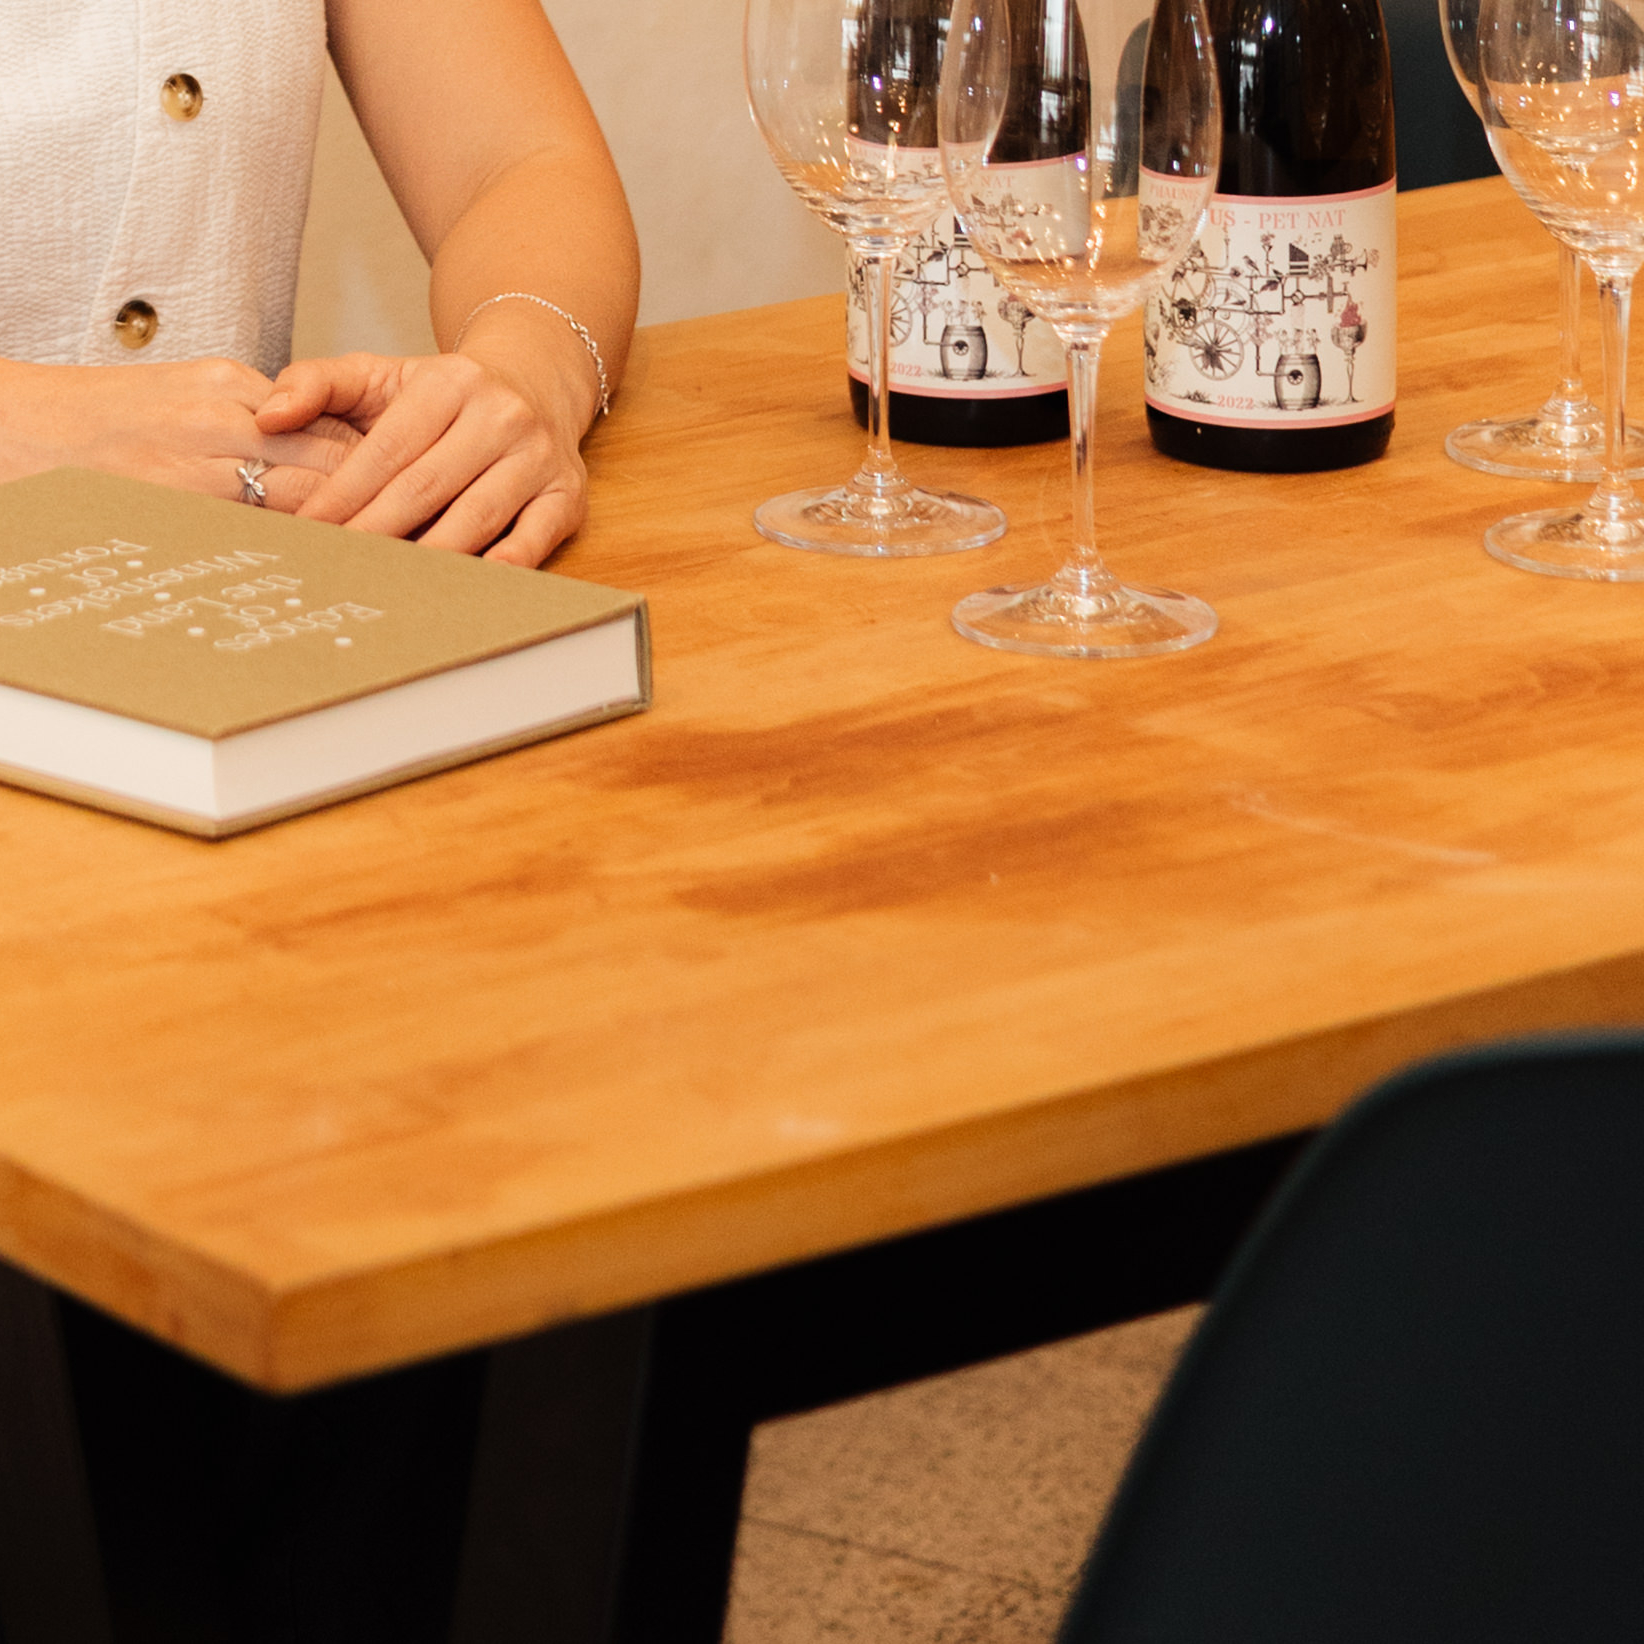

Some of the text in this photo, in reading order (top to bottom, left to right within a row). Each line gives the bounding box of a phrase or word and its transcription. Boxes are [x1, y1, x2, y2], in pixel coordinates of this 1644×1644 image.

[1259, 211, 1302, 230] PET
[1308, 209, 1346, 228] NAT
[890, 361, 923, 377] 2022
[1216, 392, 1255, 411] 2022
[63, 564, 119, 589] of
[100, 572, 303, 637] the Land
[224, 604, 277, 629] of
[213, 601, 384, 651] Echoes
